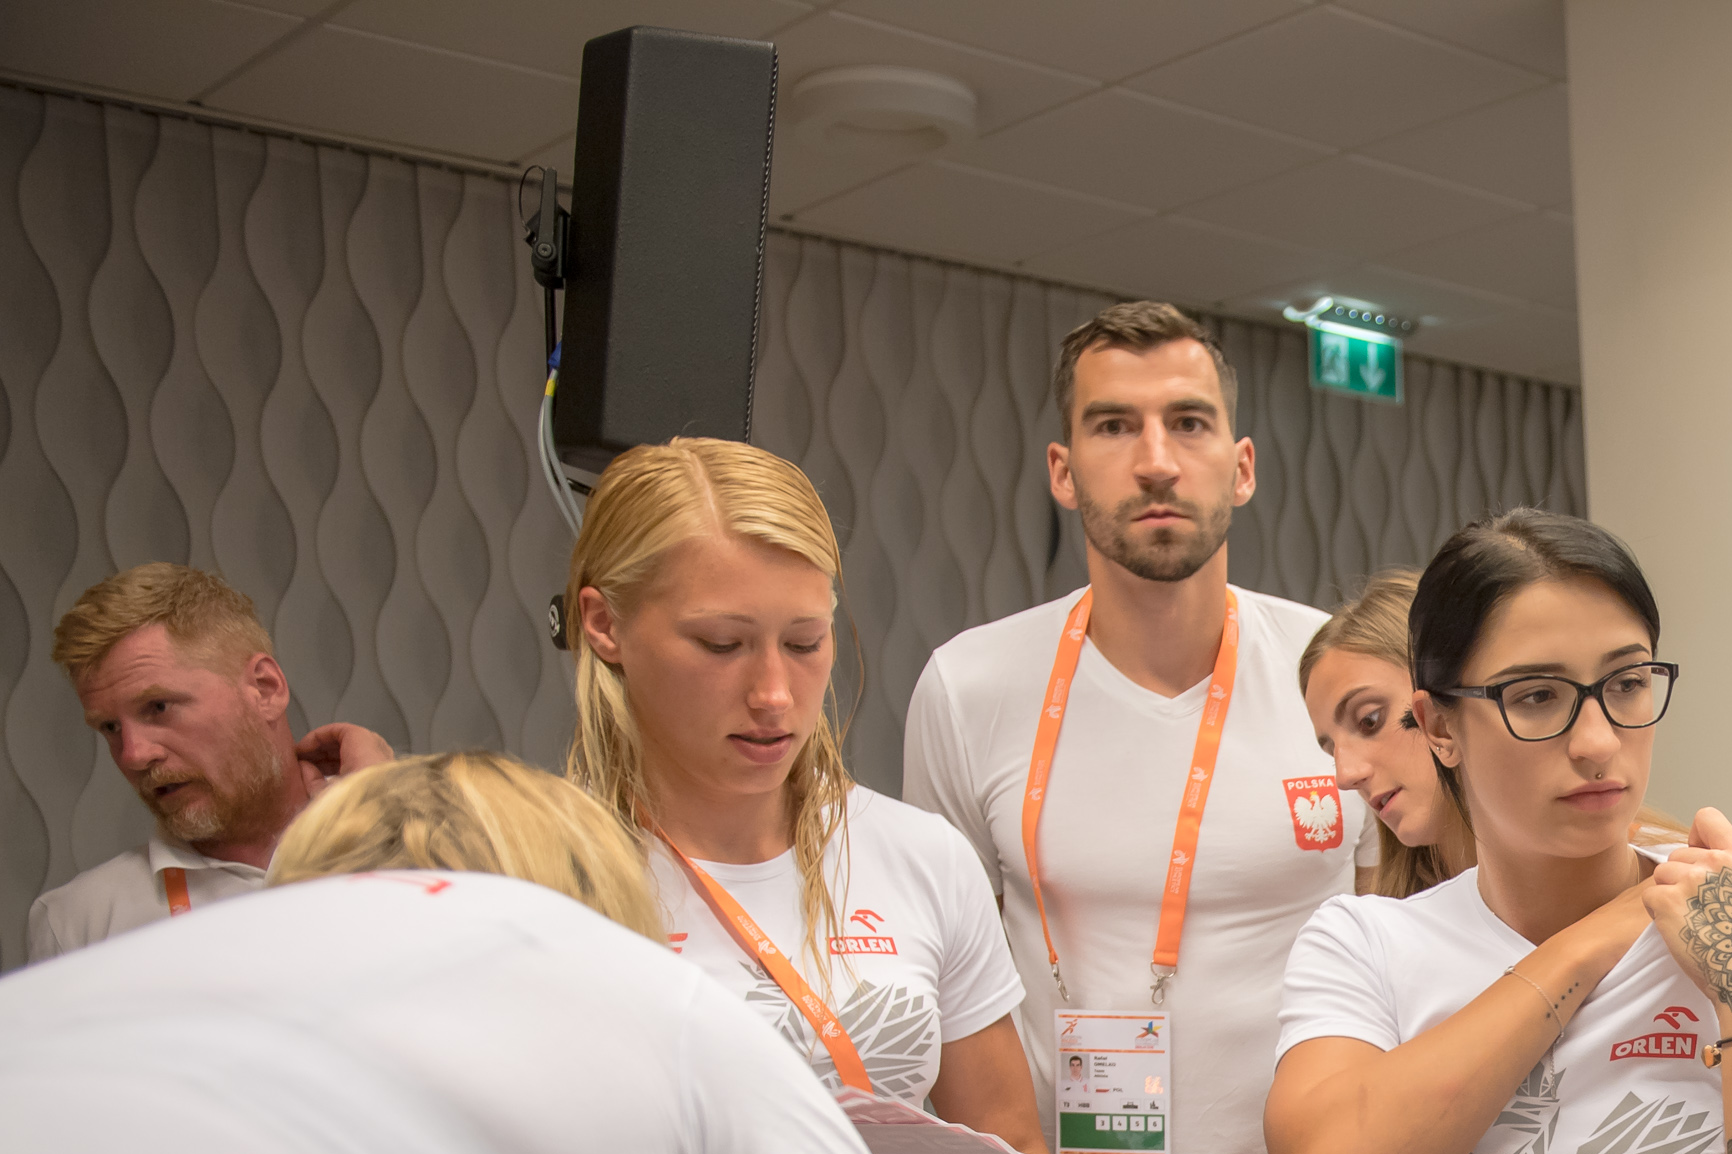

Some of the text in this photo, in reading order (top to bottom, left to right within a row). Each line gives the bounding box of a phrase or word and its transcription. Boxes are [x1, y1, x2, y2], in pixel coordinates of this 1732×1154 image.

[1286, 777, 1334, 791] POLSKA
[831, 938, 893, 953] ORLEN
[1614, 1035, 1692, 1057] ORLEN
